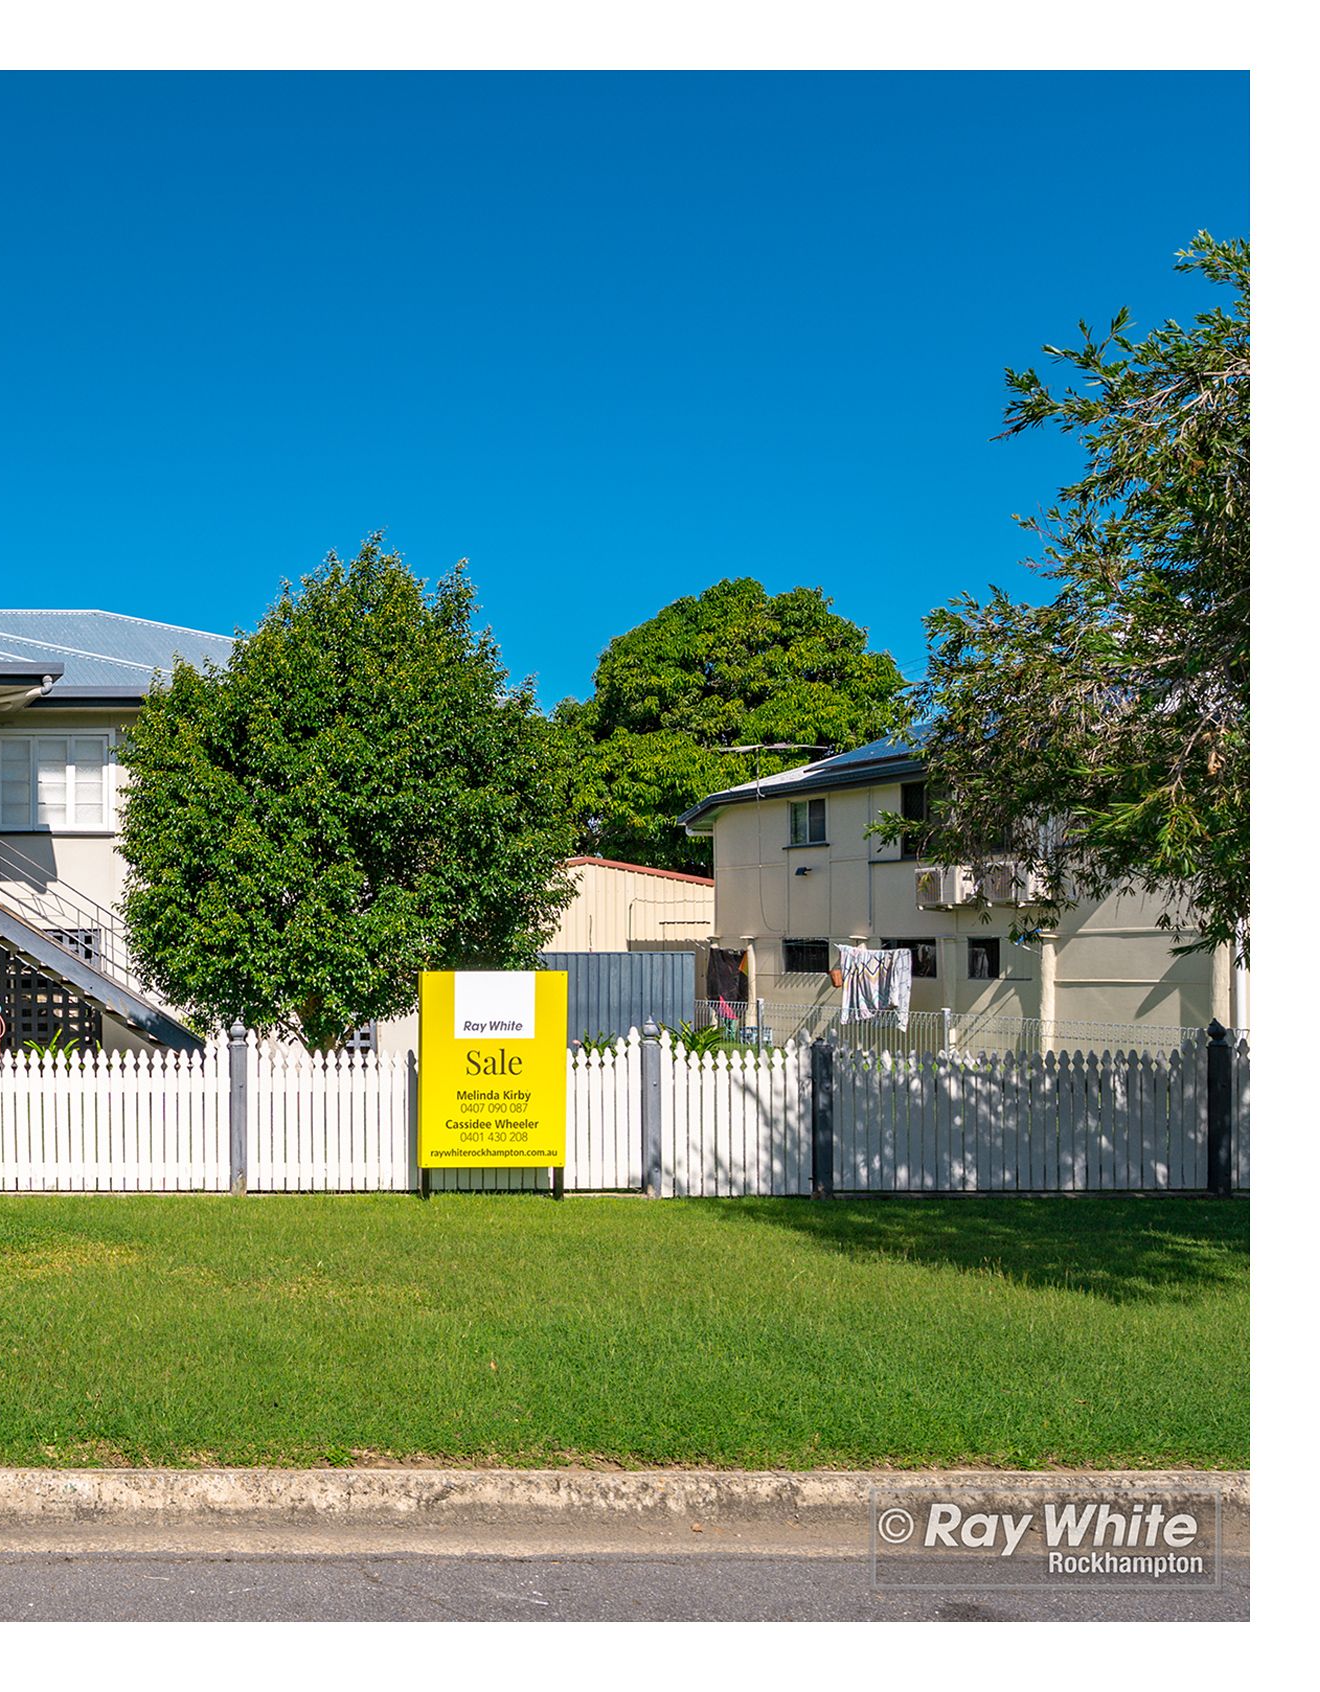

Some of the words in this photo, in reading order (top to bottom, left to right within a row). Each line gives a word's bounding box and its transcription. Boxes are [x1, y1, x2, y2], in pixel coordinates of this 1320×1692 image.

[463, 1020, 487, 1034] Ray
[489, 1020, 523, 1032] White
[466, 1048, 523, 1076] Sale
[456, 1090, 500, 1101] Melinda
[503, 1089, 532, 1102] Kirby
[460, 1102, 485, 1114] 0407
[488, 1102, 508, 1114] 090
[510, 1102, 529, 1114] 087
[445, 1118, 492, 1130] Cassidee
[494, 1118, 540, 1130] Wheeler
[460, 1131, 484, 1143] 0401
[487, 1131, 507, 1143] 430
[509, 1131, 529, 1143] 208
[430, 1147, 558, 1159] raywhiterockhampton.com.au
